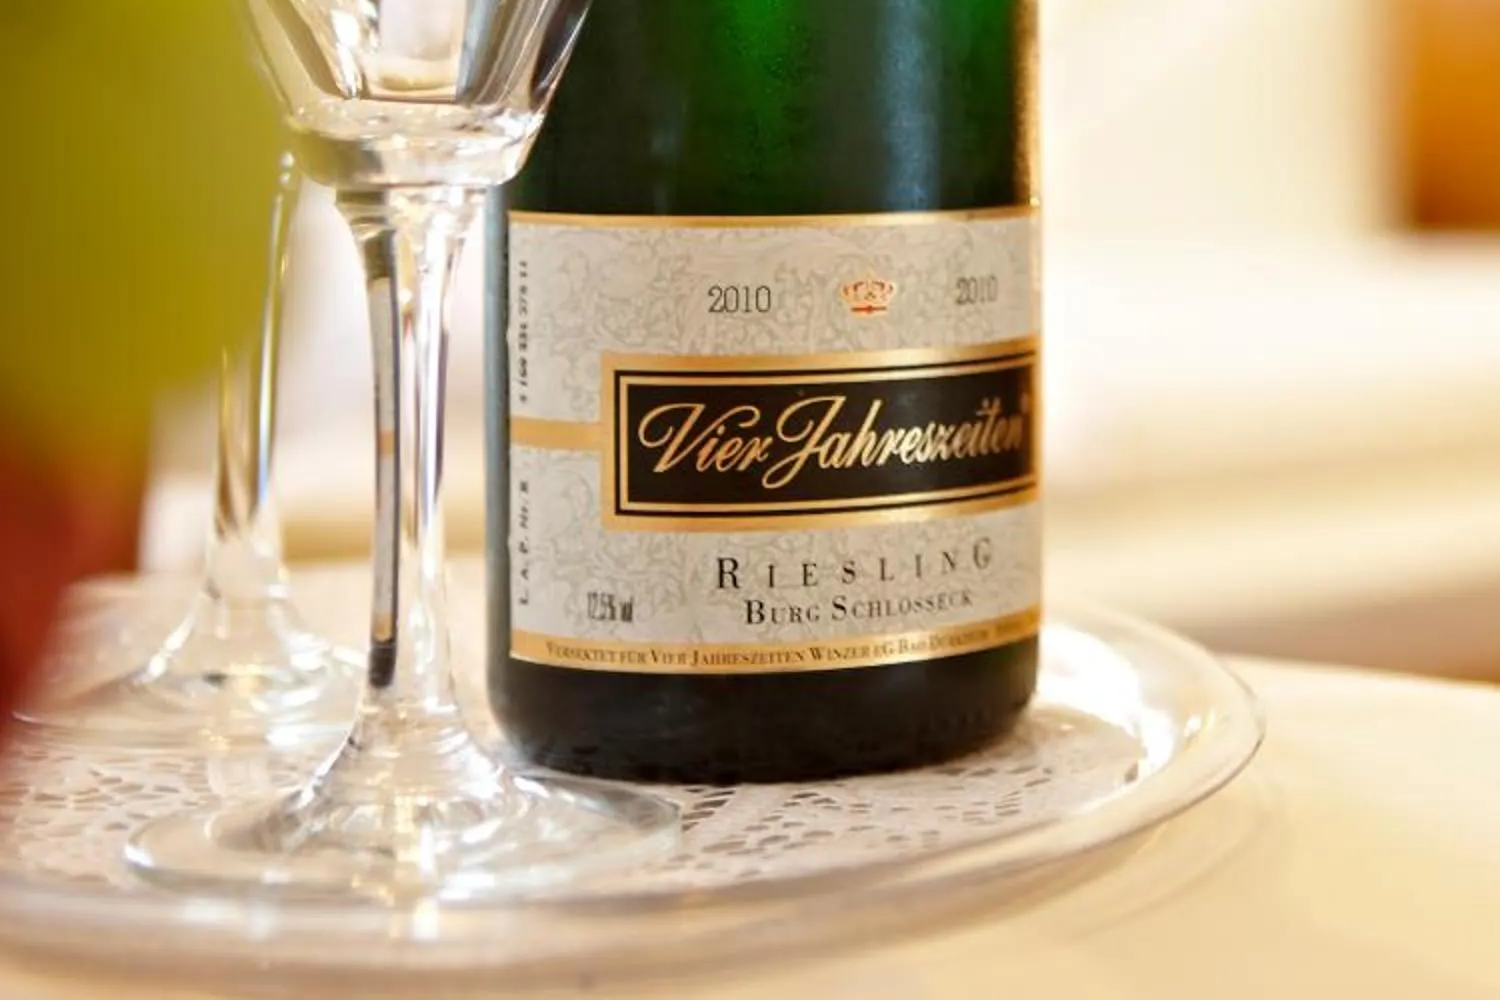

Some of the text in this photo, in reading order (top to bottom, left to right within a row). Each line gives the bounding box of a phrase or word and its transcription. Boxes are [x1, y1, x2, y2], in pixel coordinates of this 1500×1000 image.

[707, 285, 772, 314] 2010
[955, 275, 998, 305] 2010
[638, 395, 1024, 489] Vier Jahreszeiten
[717, 537, 992, 590] RIESLING
[745, 590, 973, 626] BURG SCHLOSSECK
[690, 648, 804, 667] JAHRESZEITEN
